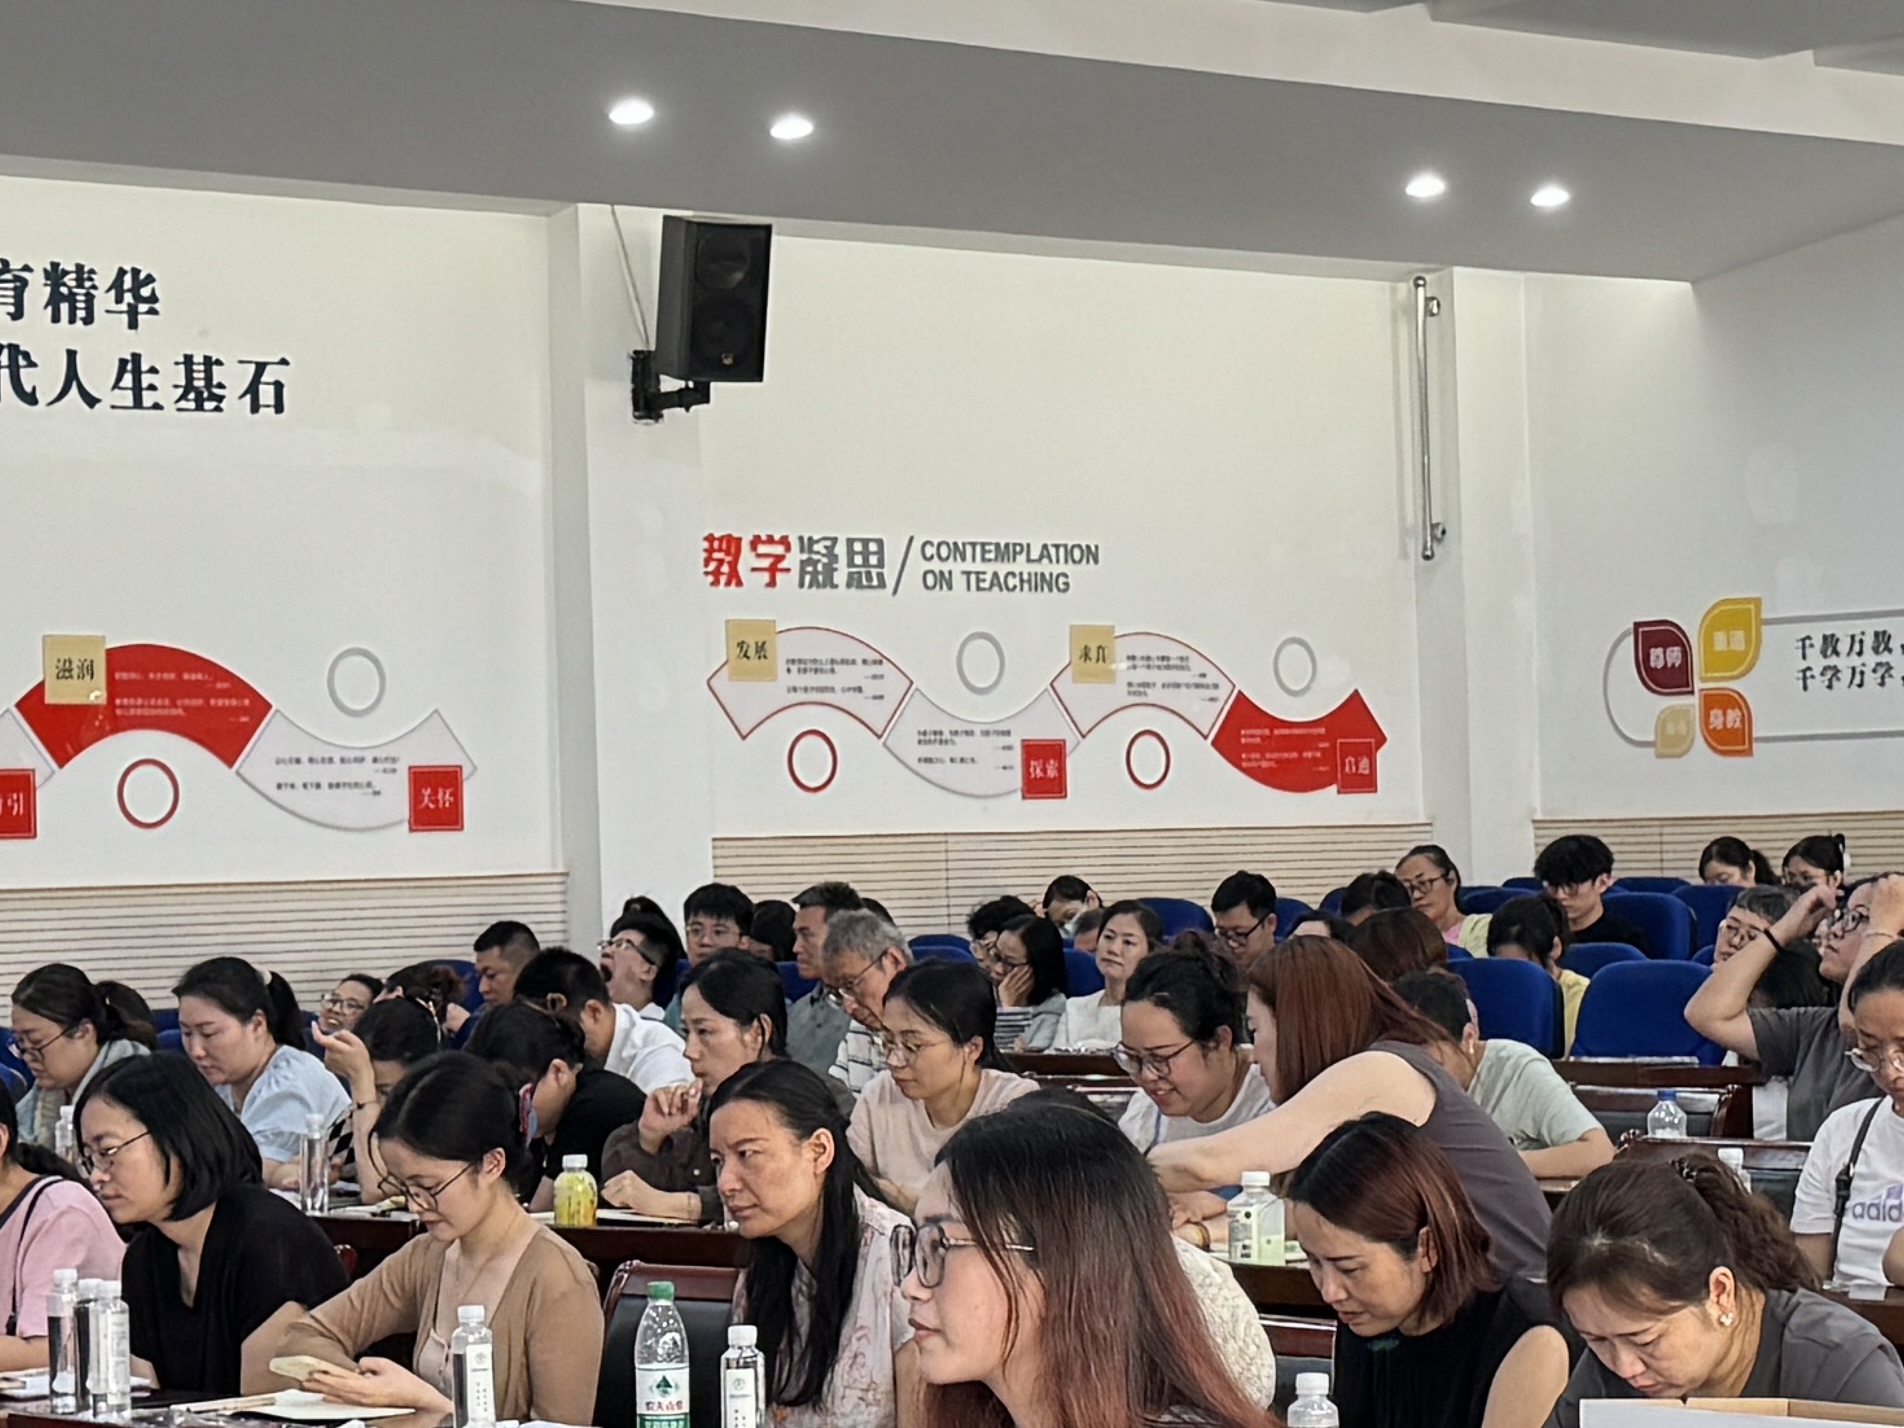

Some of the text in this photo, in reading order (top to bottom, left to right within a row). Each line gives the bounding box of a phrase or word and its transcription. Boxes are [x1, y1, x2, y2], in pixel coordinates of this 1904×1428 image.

[702, 533, 887, 589] 教学凝思
[920, 540, 1099, 565] CONTEMPLATION
[922, 569, 1071, 593] ON TEACHING
[736, 639, 769, 661] 发展
[55, 656, 94, 681] 滋润
[419, 787, 454, 810] 关怀
